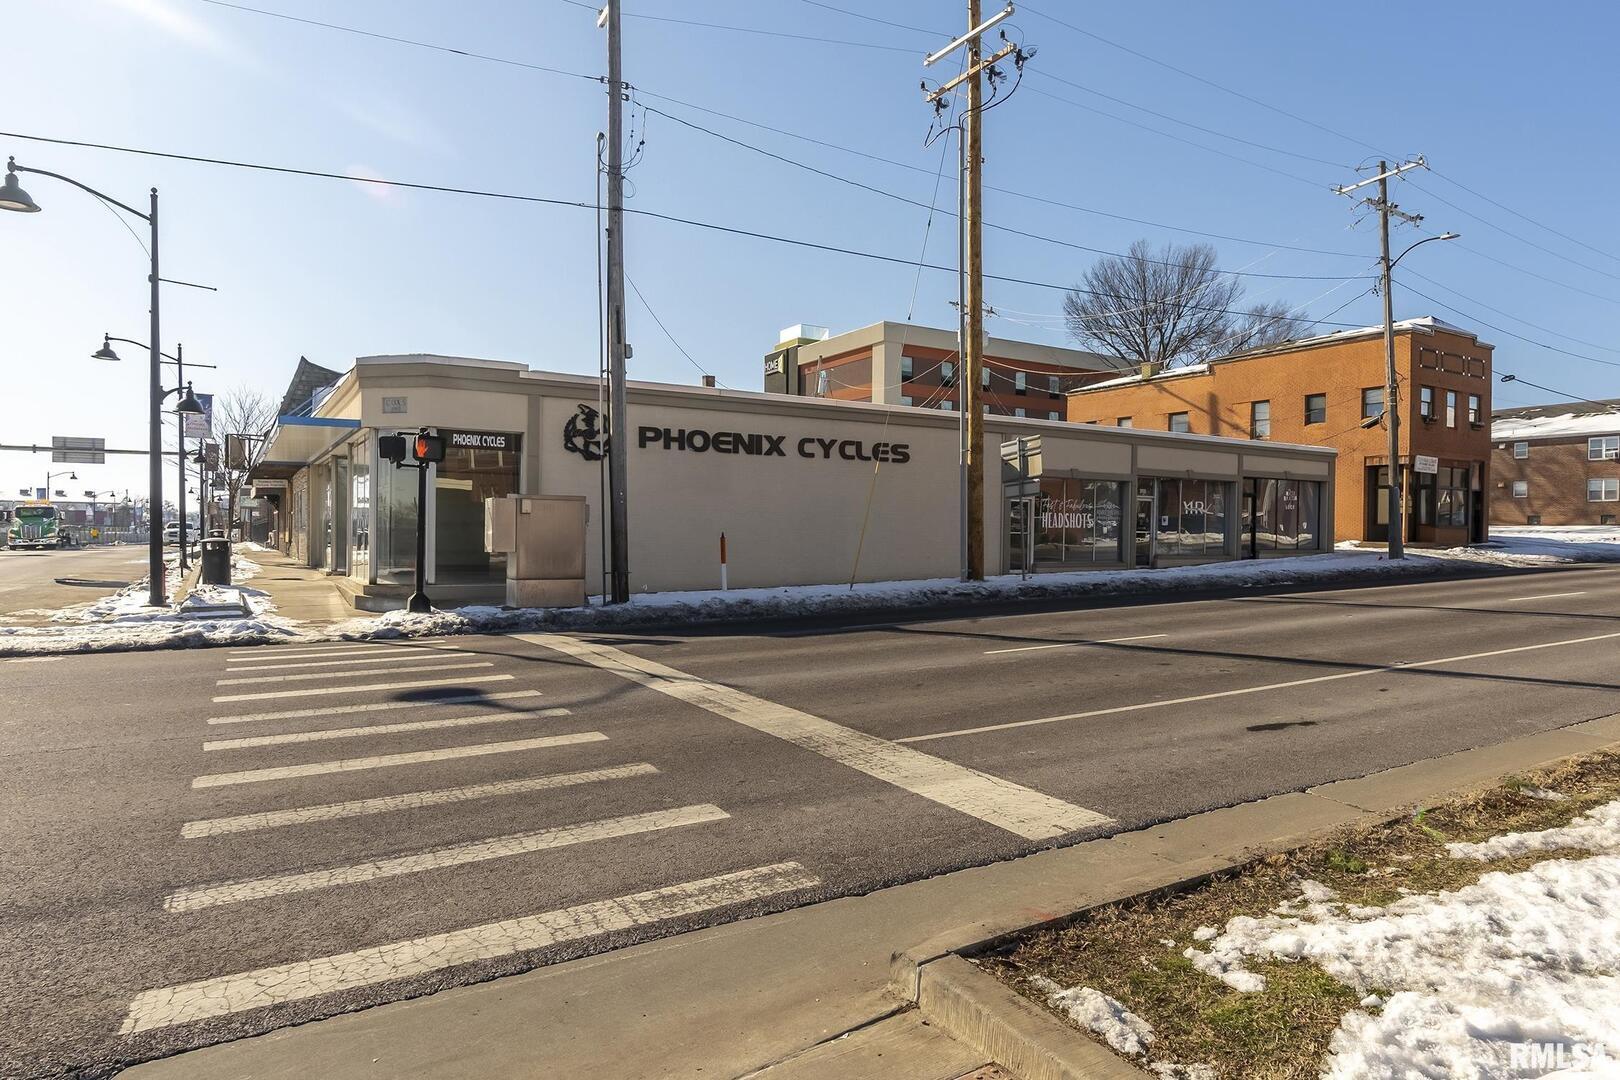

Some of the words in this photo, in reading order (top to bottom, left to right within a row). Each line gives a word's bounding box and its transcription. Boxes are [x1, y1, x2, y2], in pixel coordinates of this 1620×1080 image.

[452, 434, 481, 446] PHOENIX
[482, 435, 505, 448] CYCLES
[638, 426, 787, 457] PHOENIX
[797, 437, 911, 464] CYCLES
[1041, 512, 1092, 529] HEADSHOTS
